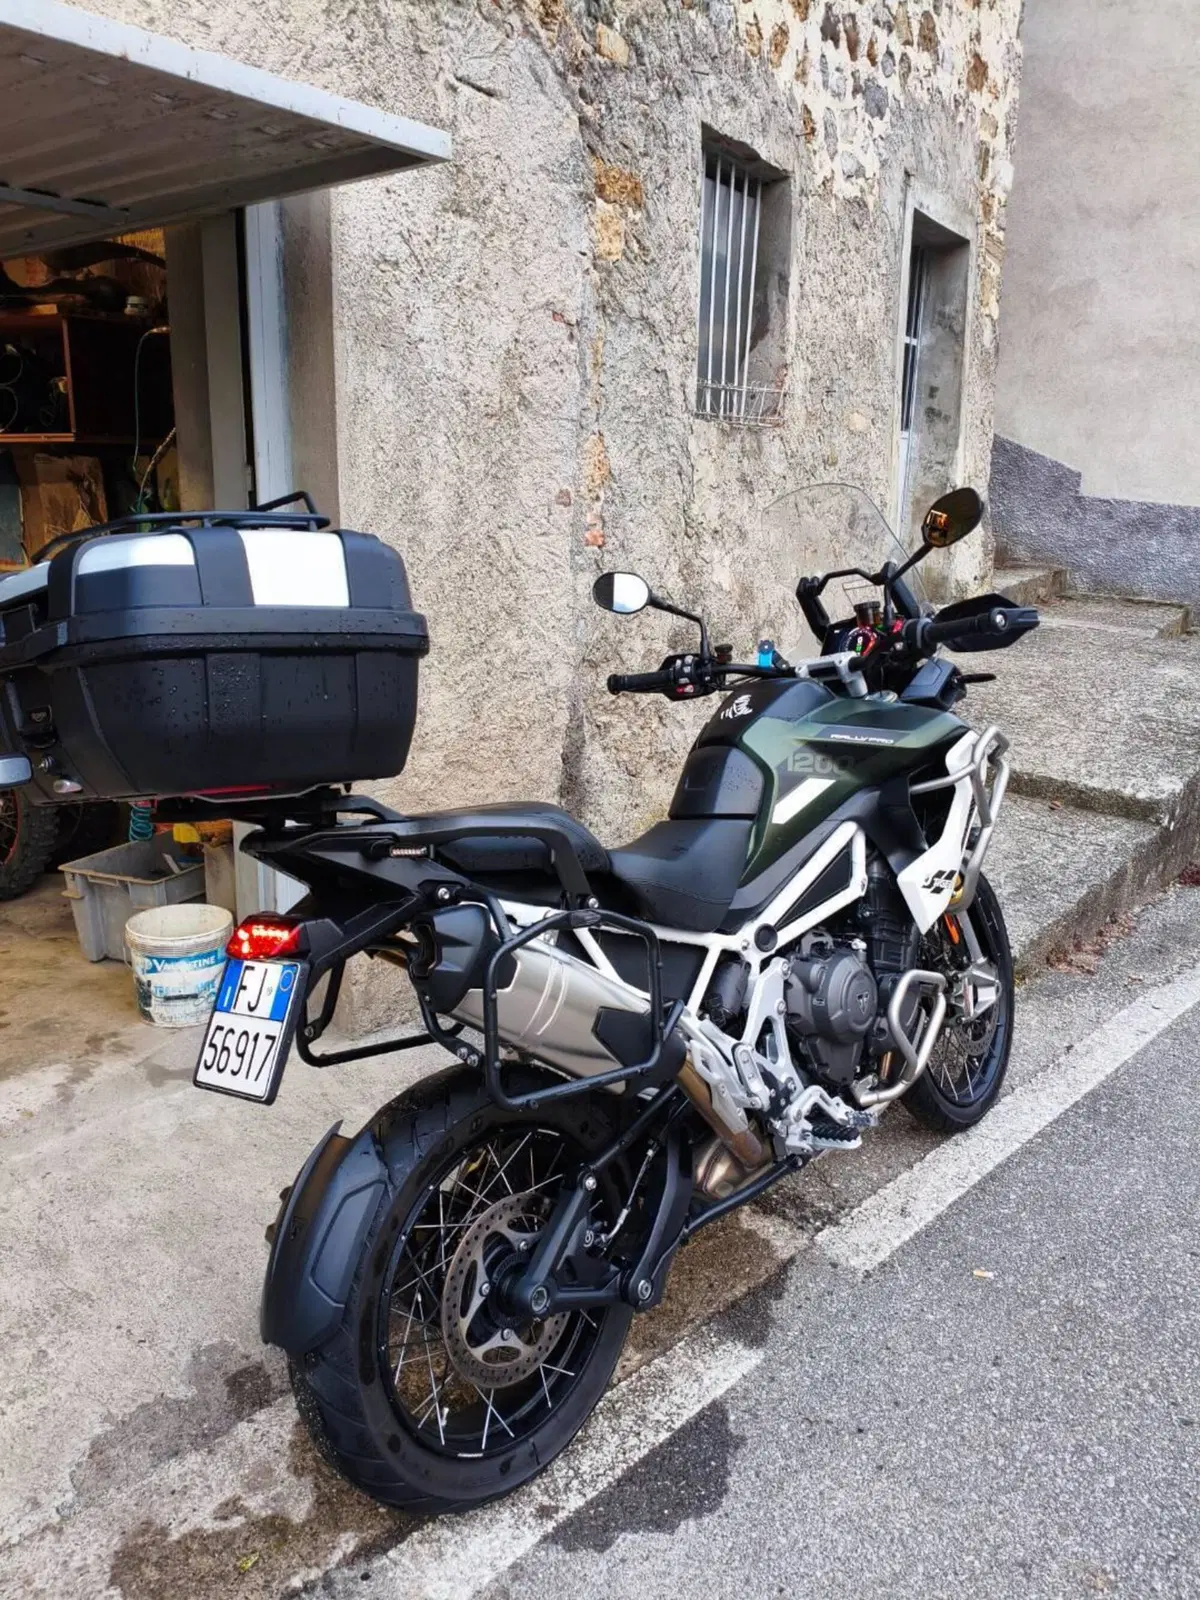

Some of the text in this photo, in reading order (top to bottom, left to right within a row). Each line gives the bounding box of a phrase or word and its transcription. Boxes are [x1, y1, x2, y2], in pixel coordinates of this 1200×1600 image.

[786, 752, 855, 774] 1200
[233, 965, 268, 1013] FJ
[203, 1025, 277, 1082] 56917
